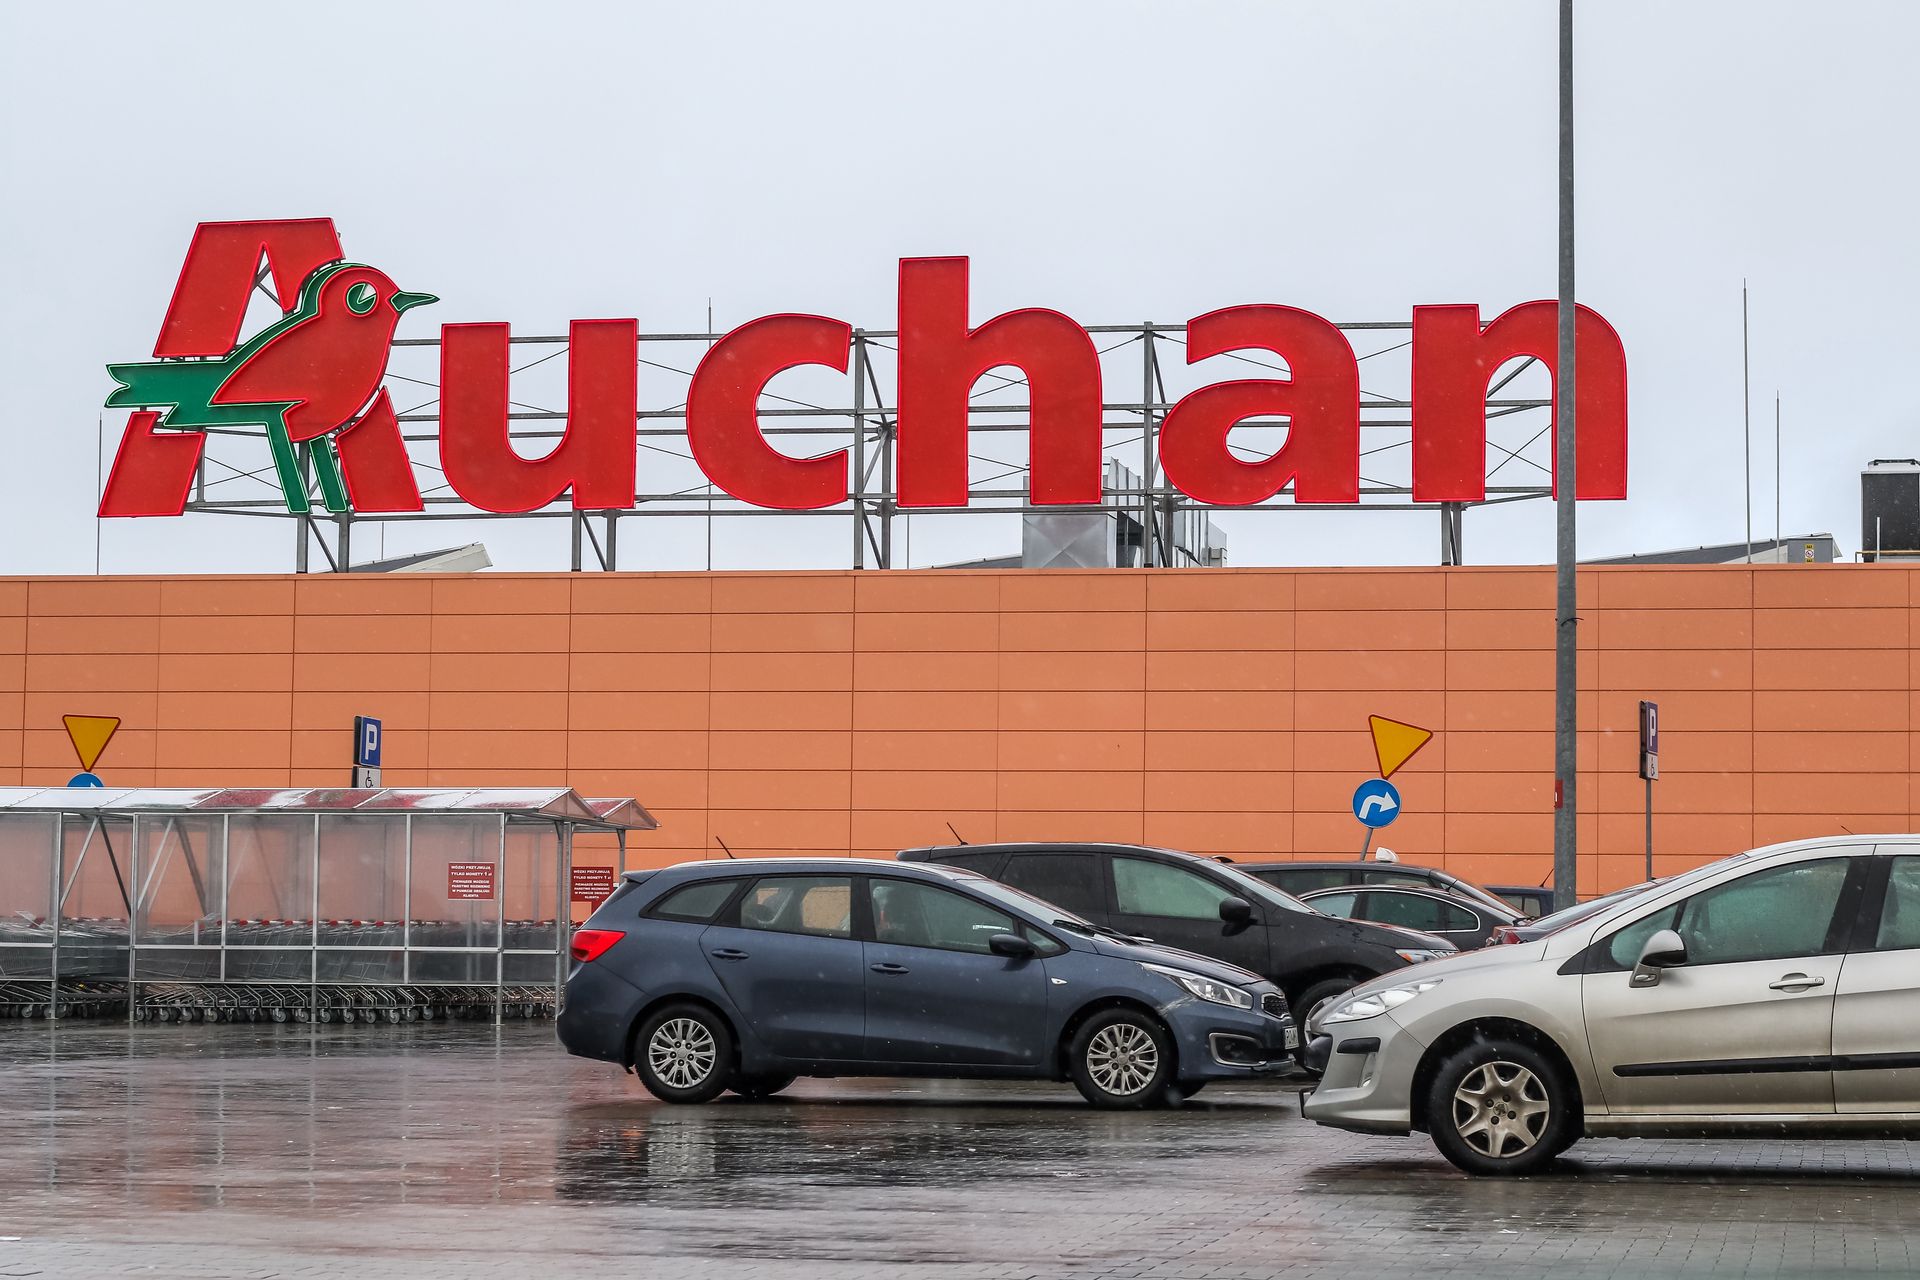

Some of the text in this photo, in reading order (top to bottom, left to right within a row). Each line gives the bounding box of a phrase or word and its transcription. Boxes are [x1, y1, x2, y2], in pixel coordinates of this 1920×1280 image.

[97, 217, 1628, 518] Auchan
[365, 723, 378, 760] P
[1649, 708, 1656, 747] P
